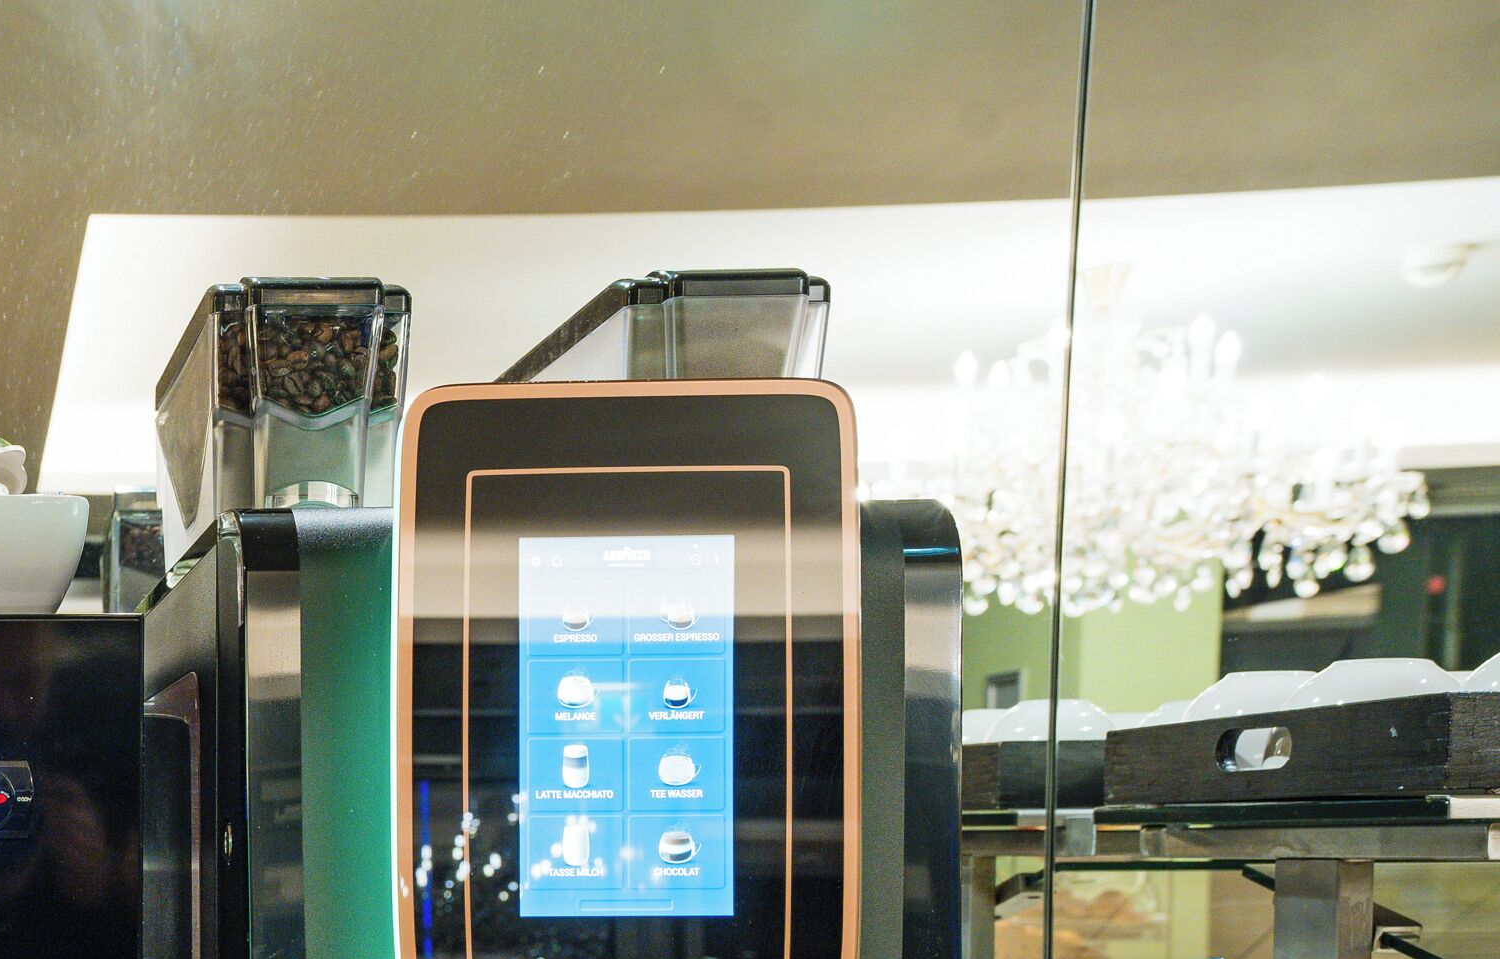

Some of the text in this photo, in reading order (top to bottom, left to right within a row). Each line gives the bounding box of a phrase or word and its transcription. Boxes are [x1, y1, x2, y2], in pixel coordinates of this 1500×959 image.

[553, 633, 598, 643] ESPRESSO
[634, 632, 720, 642] GROSSER ESPRESSO
[555, 711, 596, 721] MELANGE
[649, 710, 705, 721] VERLÄNGERT
[535, 789, 613, 800] LATTE MACCHIATO
[650, 789, 704, 799] TEE WASSER
[549, 867, 575, 877] TASSE
[653, 867, 700, 877] CHOCOLAT
